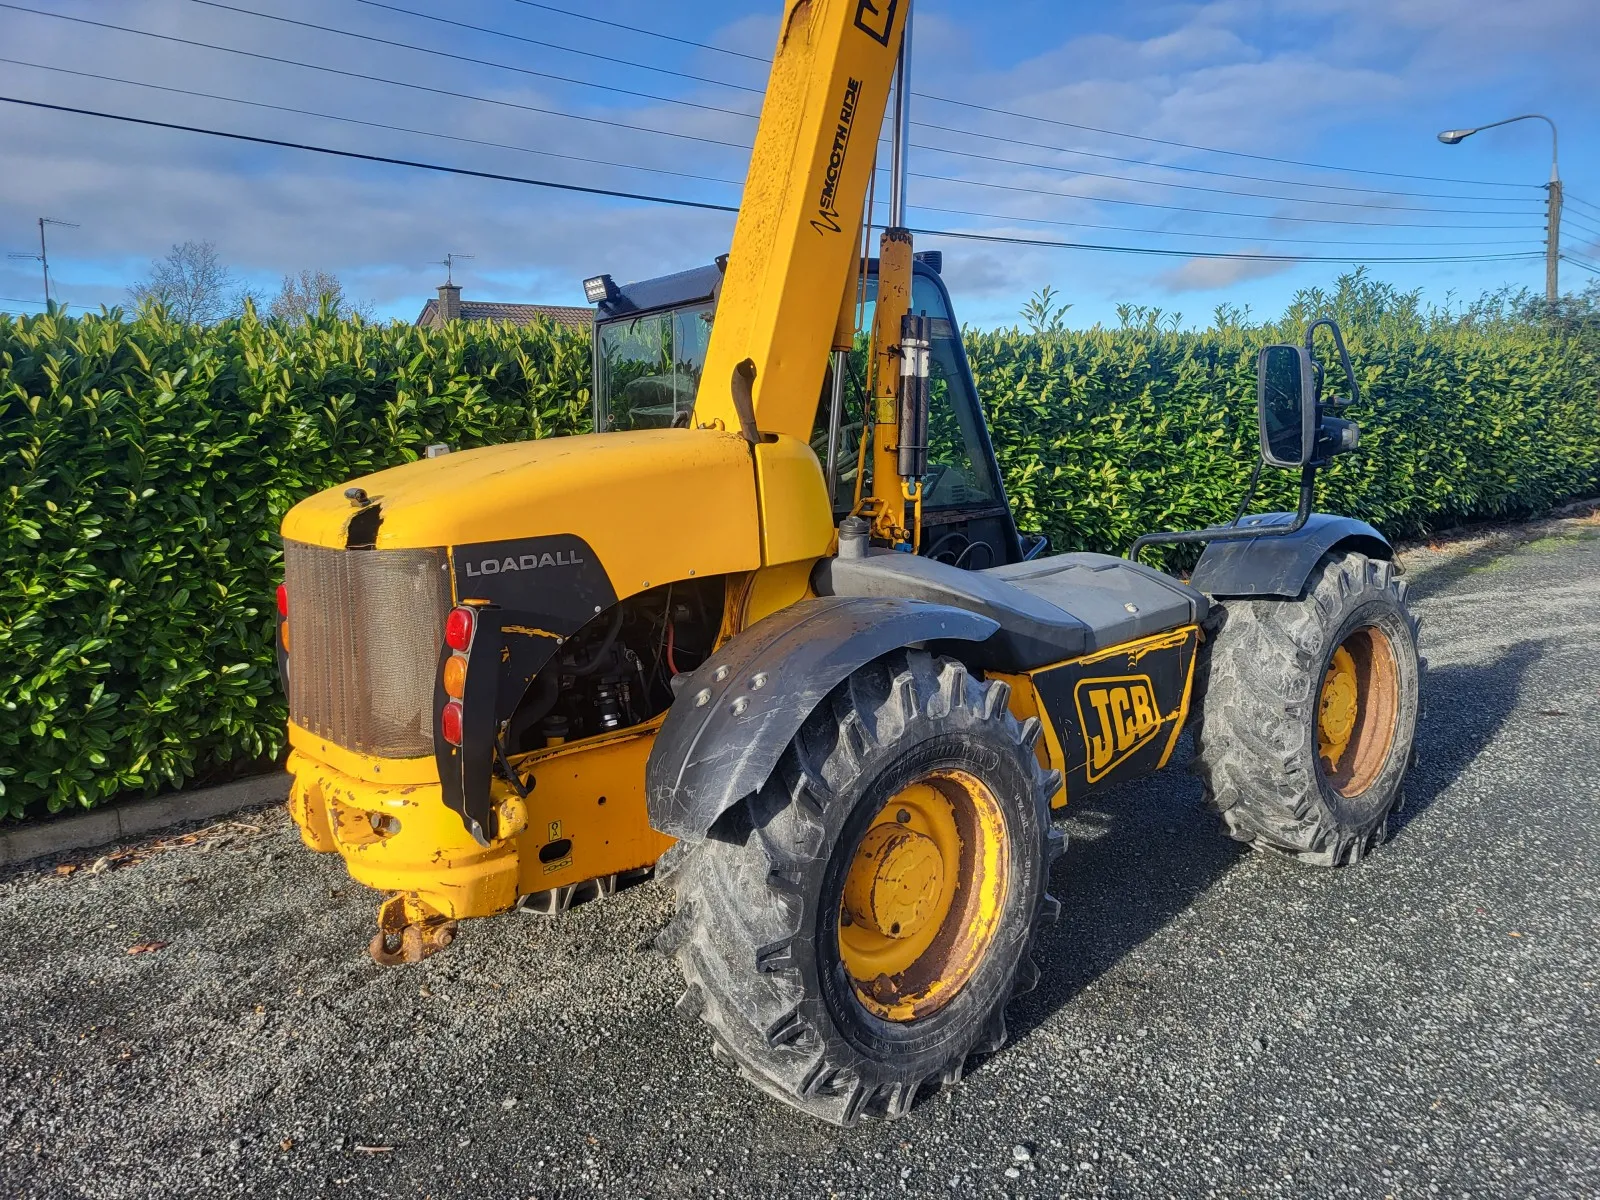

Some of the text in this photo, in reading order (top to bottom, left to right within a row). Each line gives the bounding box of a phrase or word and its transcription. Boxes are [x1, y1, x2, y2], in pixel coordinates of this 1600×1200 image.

[819, 76, 860, 209] SMOOTH RIDE
[465, 549, 584, 577] LOADALL
[1088, 685, 1154, 770] JCB
